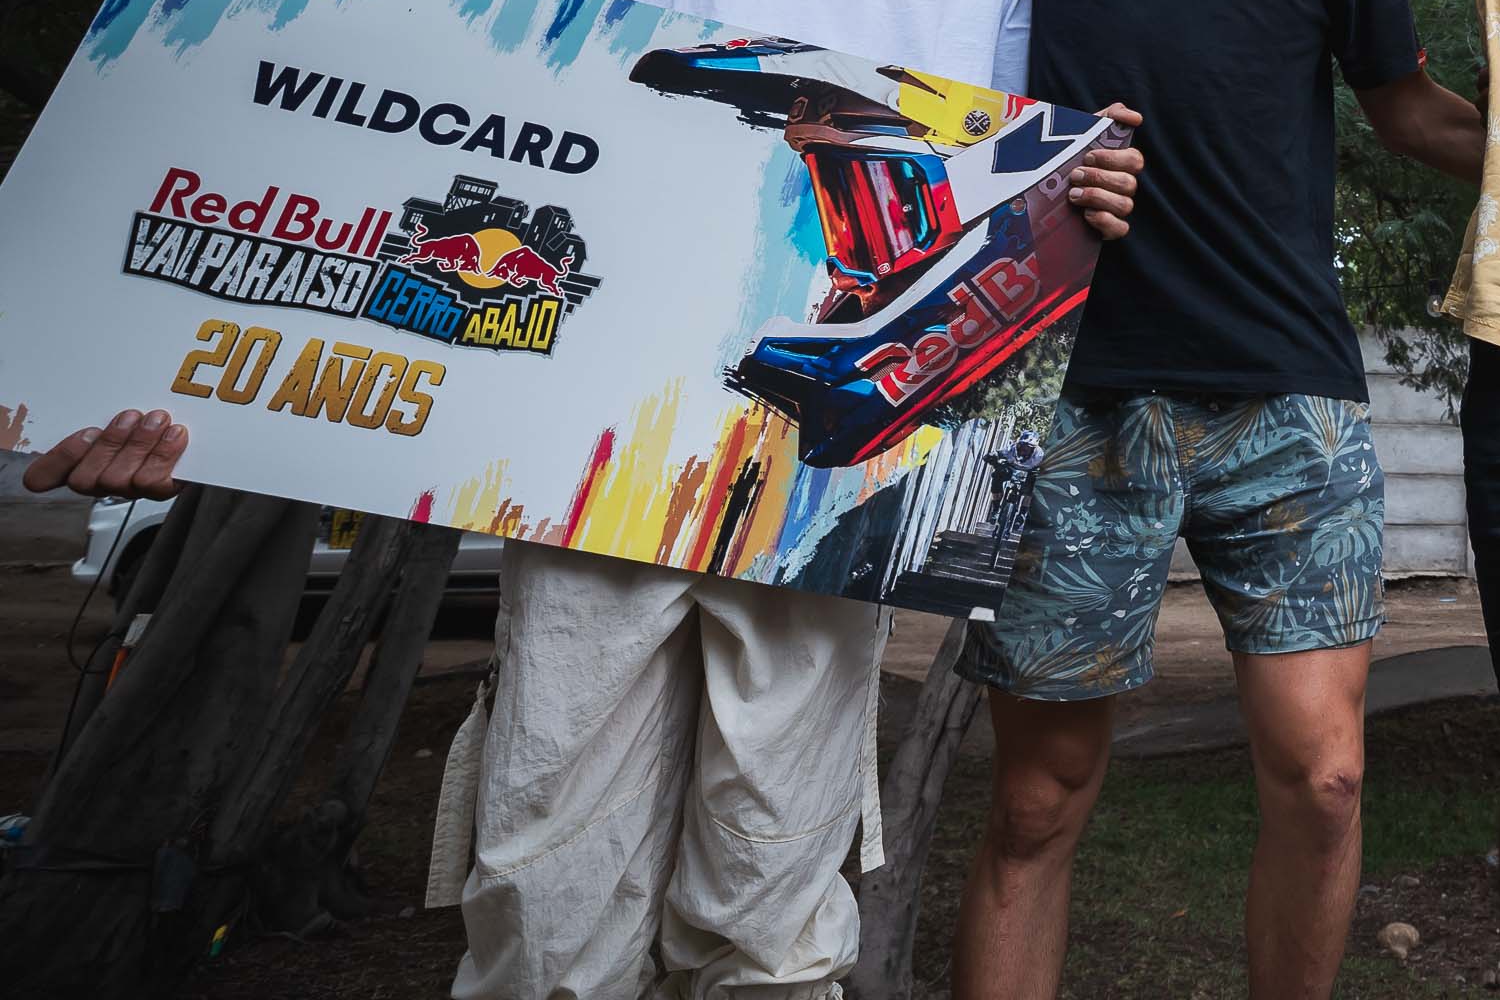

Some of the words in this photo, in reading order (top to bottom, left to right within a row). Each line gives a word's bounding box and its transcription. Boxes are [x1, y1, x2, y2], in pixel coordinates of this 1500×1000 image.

[253, 60, 600, 175] WILDCARD
[149, 167, 280, 237] Red
[272, 193, 392, 257] Bull
[130, 218, 372, 313] VALPARAISO
[369, 271, 465, 339] CERRO
[464, 300, 557, 349] ABAJO
[171, 320, 283, 405] 20
[267, 337, 446, 437] AÑOS
